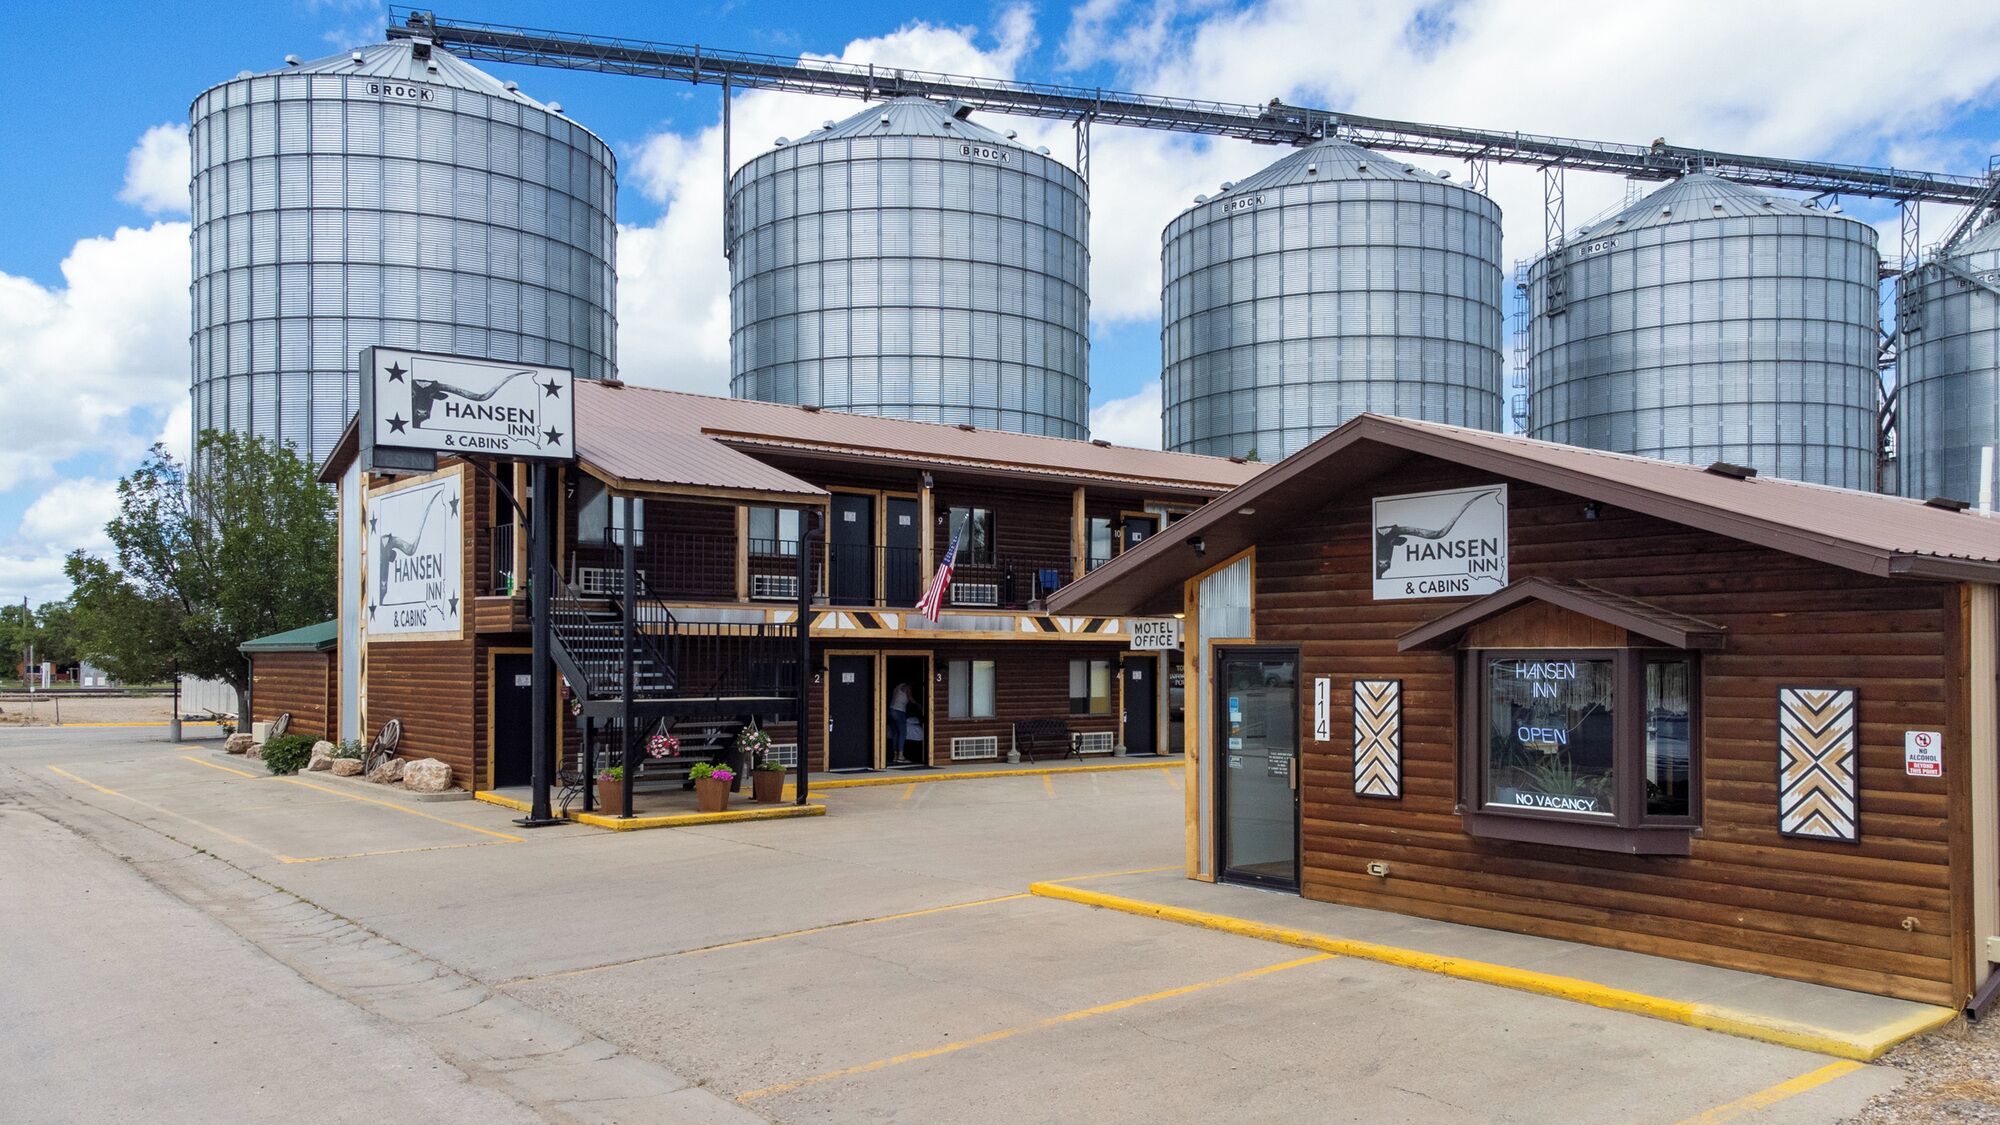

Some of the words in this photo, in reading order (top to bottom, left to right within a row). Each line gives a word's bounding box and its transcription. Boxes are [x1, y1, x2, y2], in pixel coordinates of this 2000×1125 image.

[371, 84, 429, 100] BROCK
[963, 146, 1007, 161] BROCK
[1224, 196, 1262, 212] BROCK
[446, 402, 534, 424] HANSEN
[508, 424, 535, 436] INN
[445, 434, 454, 446] &
[459, 436, 508, 449] CABINS
[568, 489, 574, 498] 7
[938, 517, 943, 525] 9
[1114, 530, 1121, 538] 10
[1406, 538, 1497, 561] HANSEN
[394, 552, 442, 583] HANSEN
[1468, 558, 1498, 573] INN
[426, 582, 441, 600] INN
[1405, 582, 1415, 594] &
[1419, 579, 1469, 593] CABINS
[394, 611, 399, 627] &
[400, 609, 427, 627] CABINS
[1134, 622, 1173, 634] MOTEL
[1134, 635, 1173, 647] OFFICE
[937, 673, 942, 682] 3
[1515, 662, 1575, 679] HANSEN
[814, 674, 820, 683] 2
[1533, 682, 1557, 698] INN
[1317, 681, 1328, 738] 114
[1518, 726, 1567, 745] OPEN
[1515, 793, 1533, 806] NO
[1536, 795, 1595, 812] VACANCY
